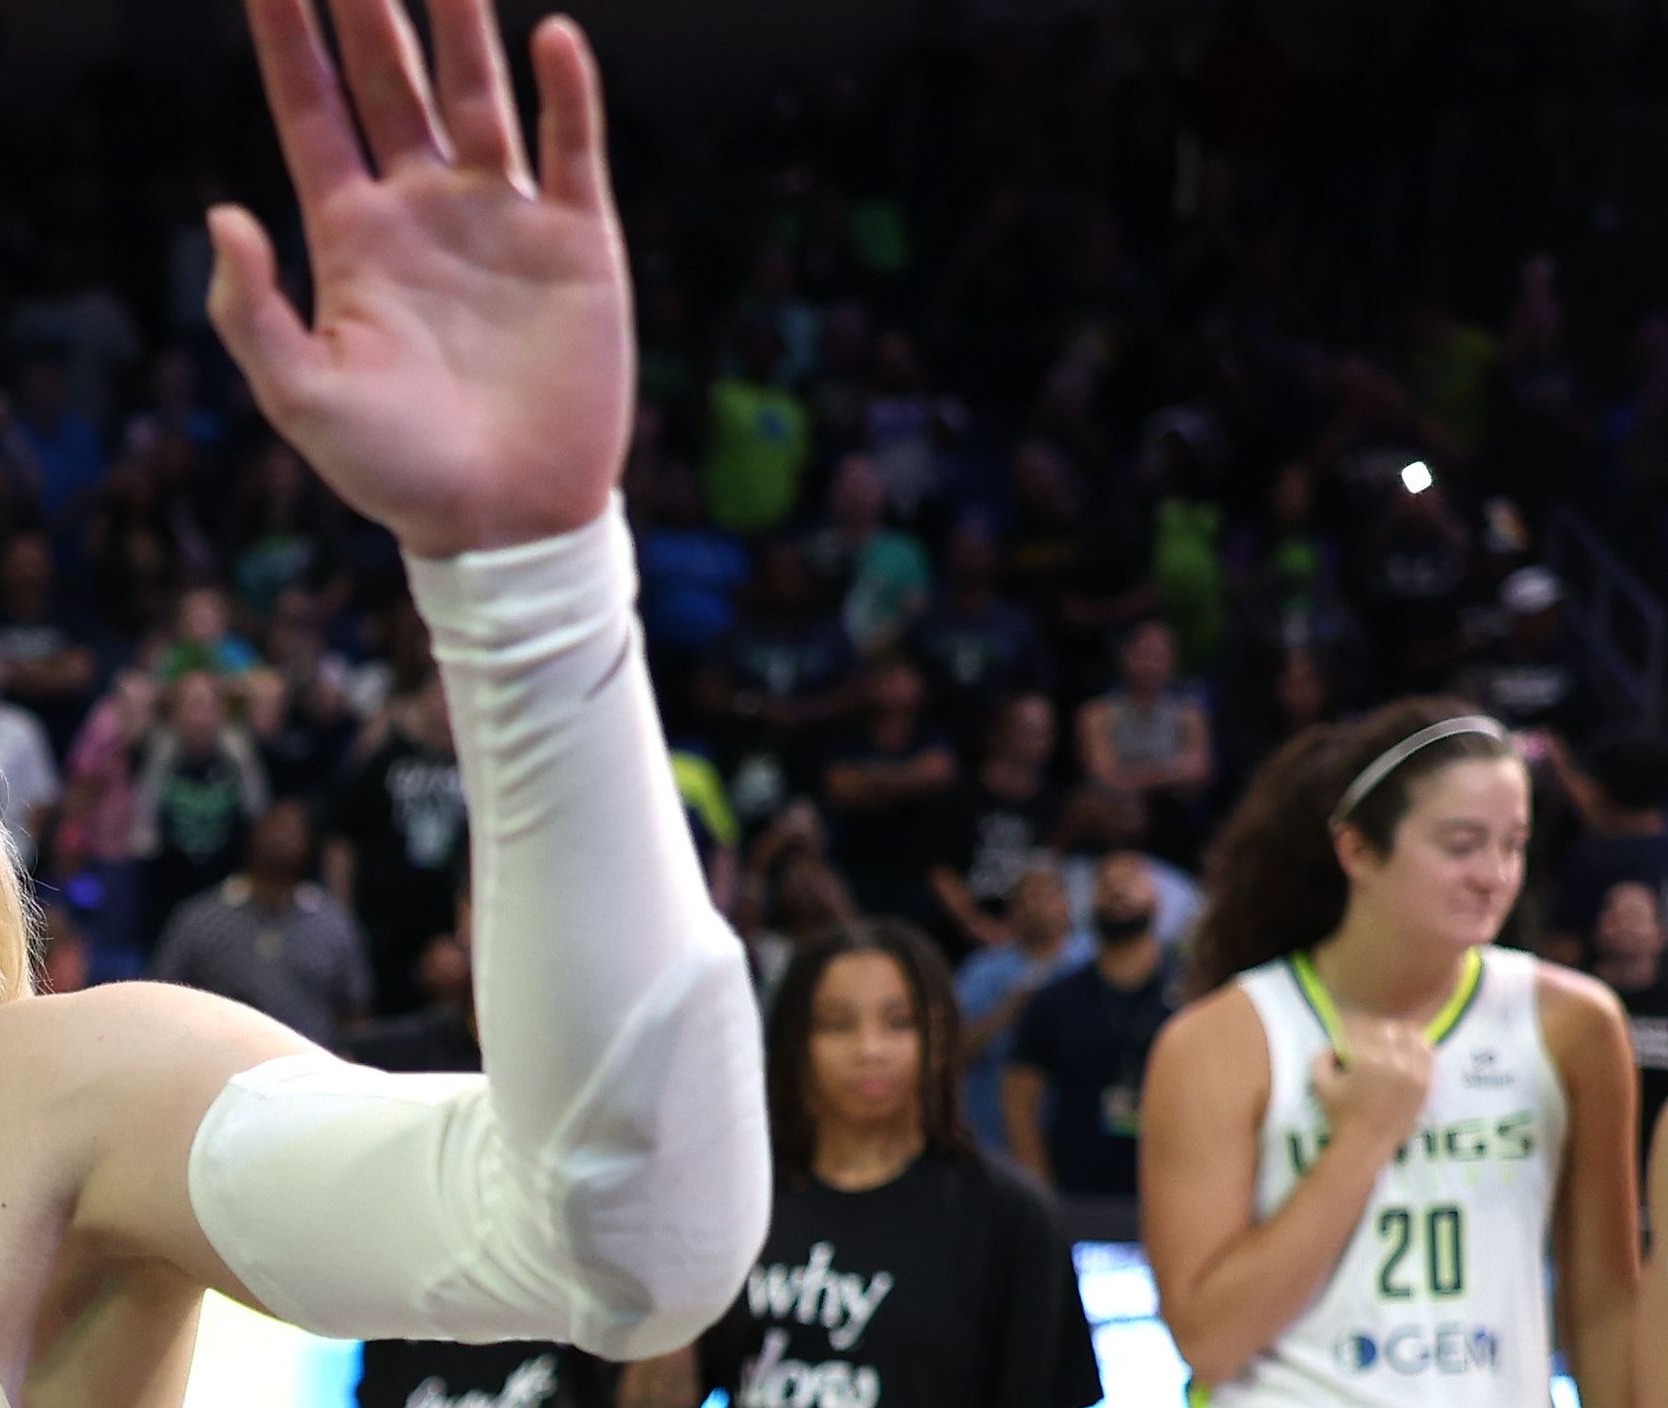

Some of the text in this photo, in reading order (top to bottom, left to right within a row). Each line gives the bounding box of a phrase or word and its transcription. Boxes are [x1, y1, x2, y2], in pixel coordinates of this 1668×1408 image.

[748, 1240, 896, 1351] why
[1376, 1203, 1467, 1301] 20
[1384, 1322, 1501, 1376] GEM
